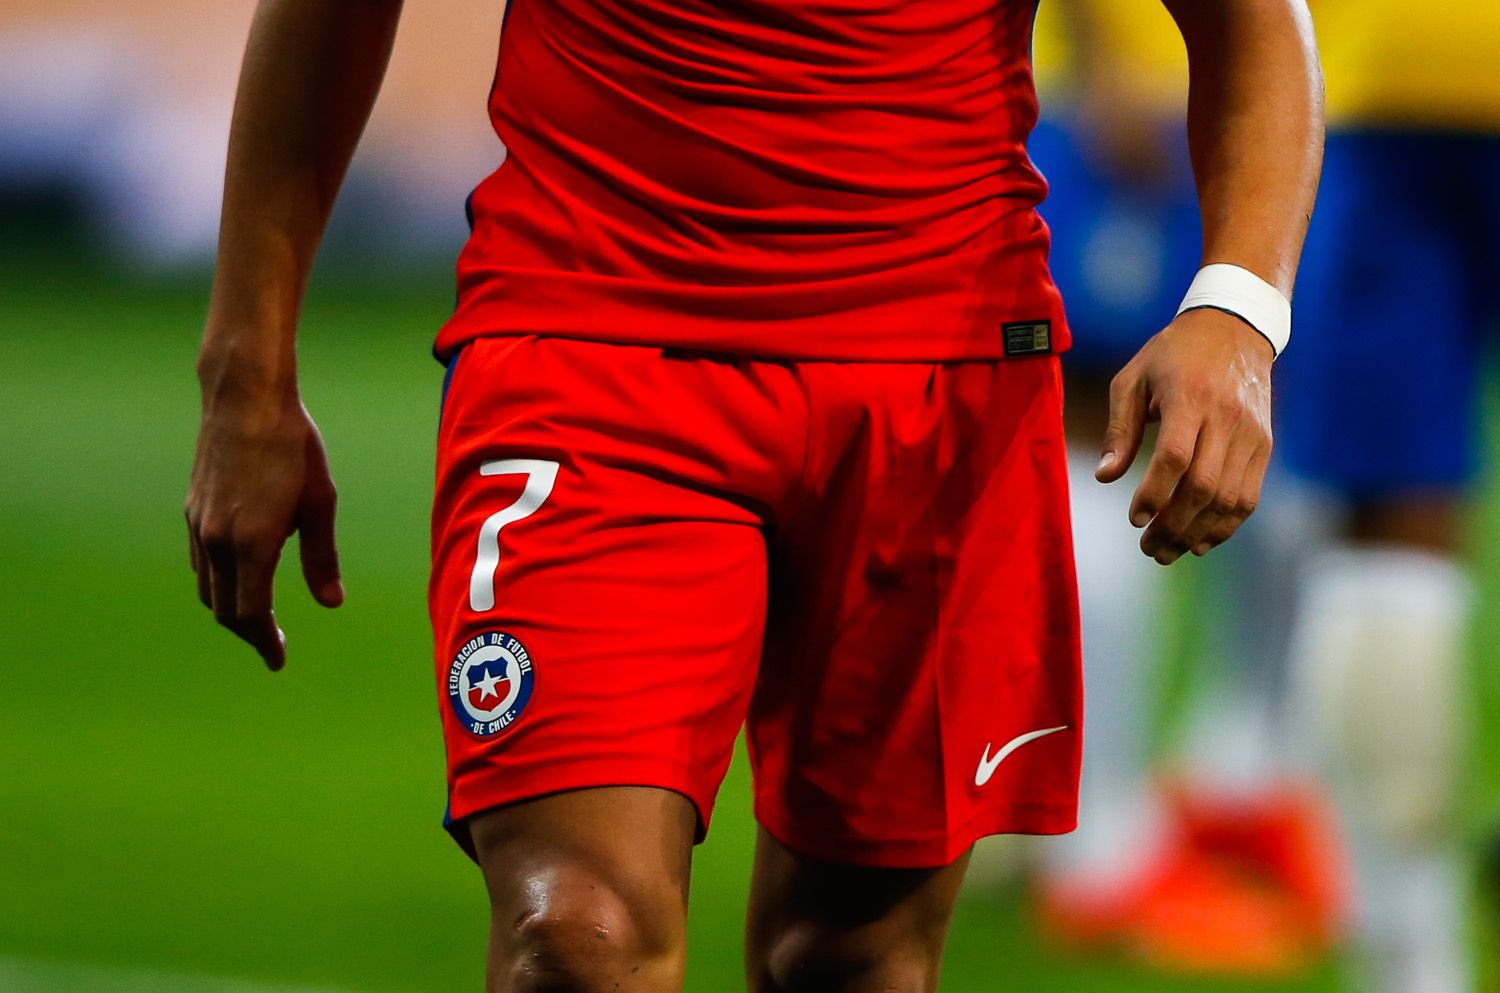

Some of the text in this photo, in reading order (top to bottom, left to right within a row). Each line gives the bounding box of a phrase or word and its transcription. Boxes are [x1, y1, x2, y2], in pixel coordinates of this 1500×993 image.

[470, 459, 560, 611] 7
[449, 633, 532, 696] FEDERACION DE FUTBOL
[473, 711, 514, 735] DE CHILE
